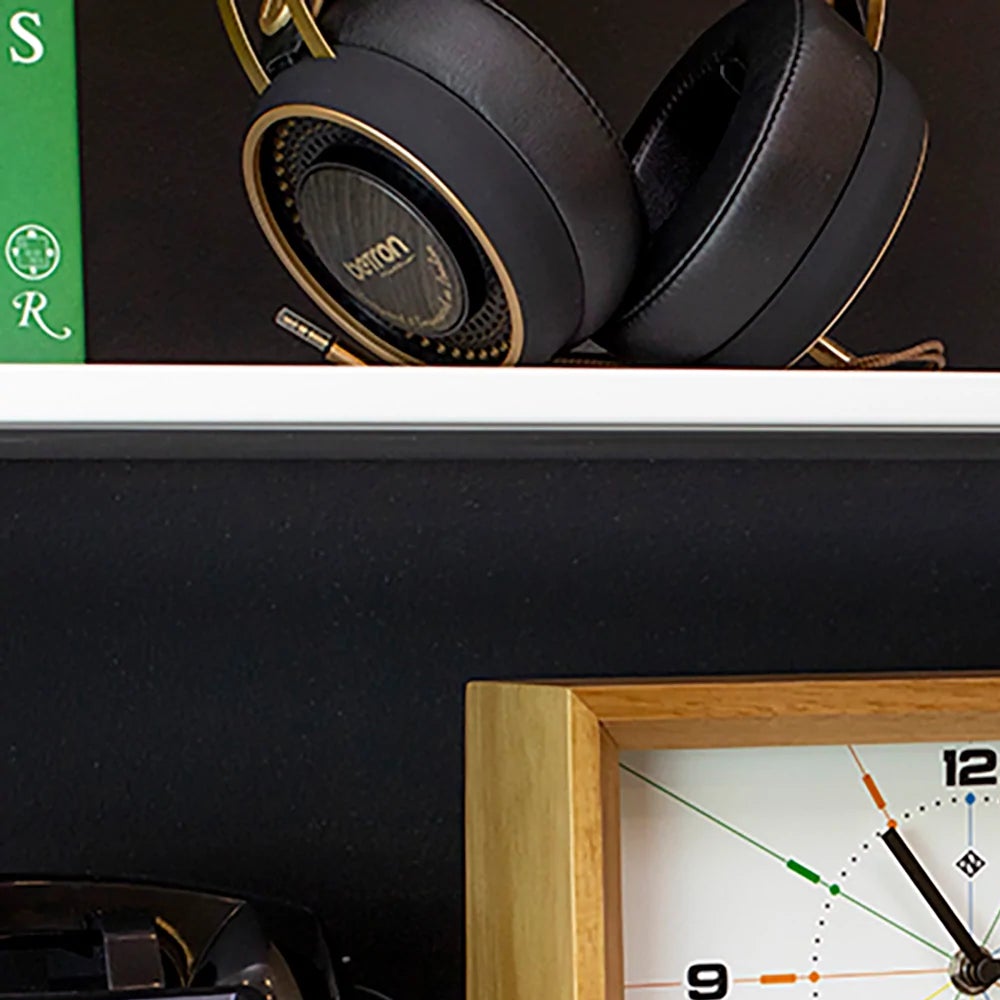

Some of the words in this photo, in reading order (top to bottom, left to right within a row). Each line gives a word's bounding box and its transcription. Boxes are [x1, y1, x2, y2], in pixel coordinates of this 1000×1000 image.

[9, 11, 44, 64] S
[12, 290, 72, 340] R
[943, 748, 998, 787] 12
